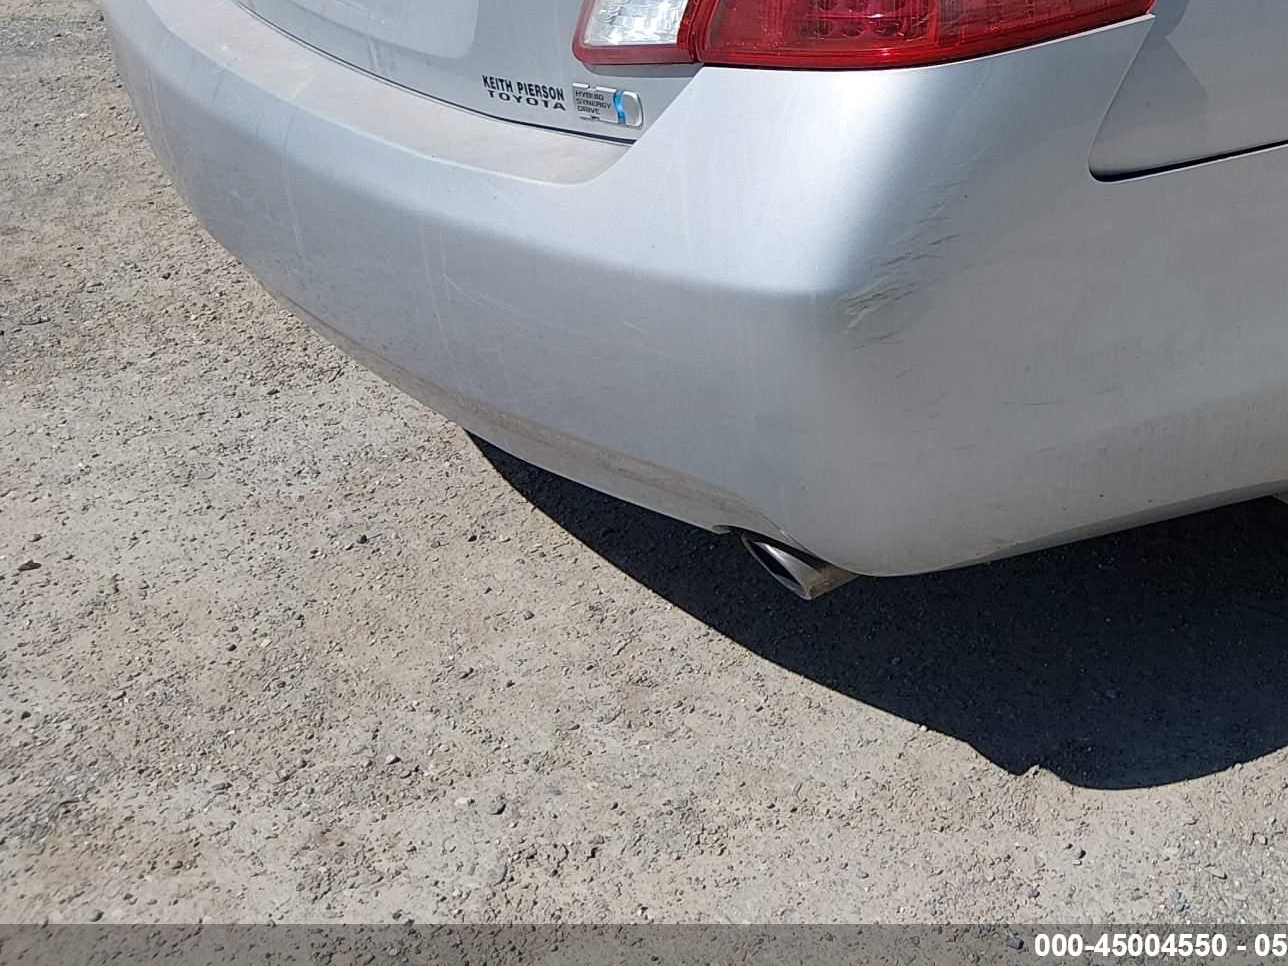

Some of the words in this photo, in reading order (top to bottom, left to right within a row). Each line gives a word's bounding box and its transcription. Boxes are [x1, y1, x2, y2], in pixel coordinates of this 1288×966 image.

[482, 74, 514, 94] KEITH
[517, 81, 565, 101] PIERSON
[487, 90, 566, 111] TOYOTA
[575, 97, 611, 109] SYNERGY
[577, 105, 601, 115] DRIVE
